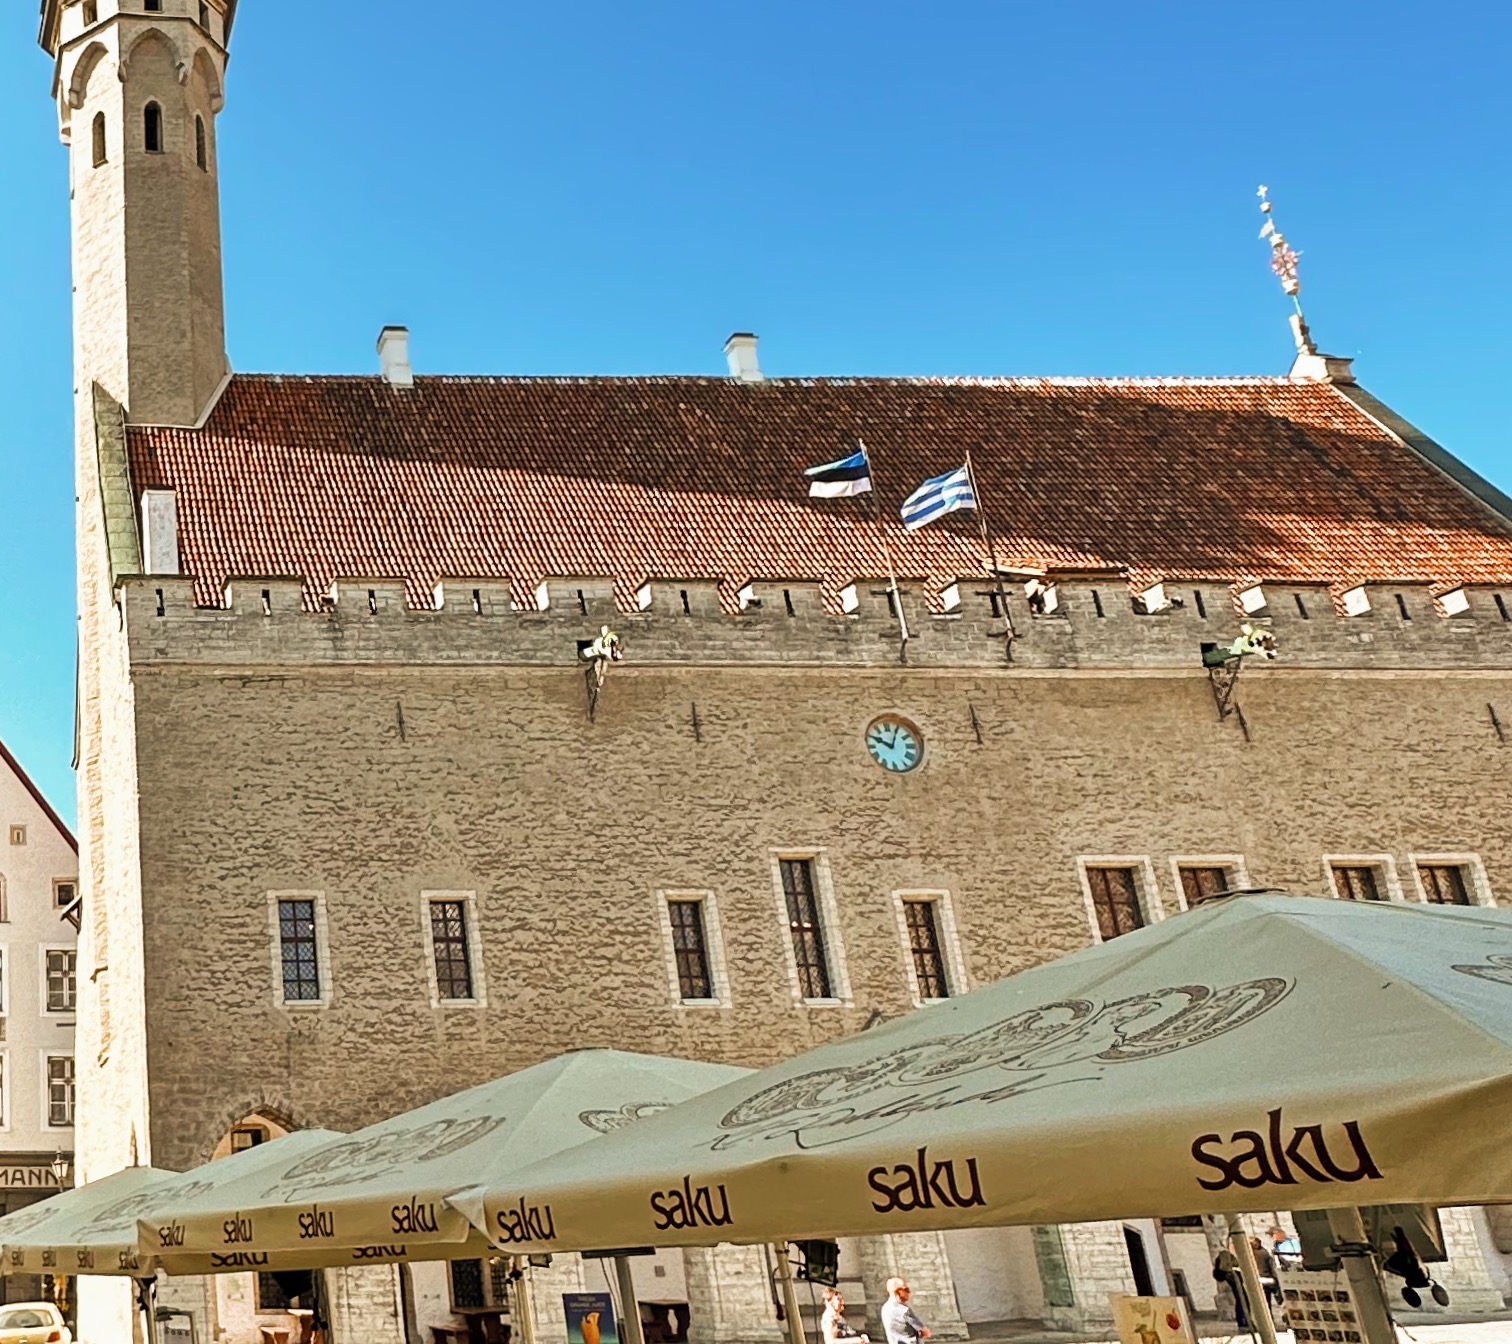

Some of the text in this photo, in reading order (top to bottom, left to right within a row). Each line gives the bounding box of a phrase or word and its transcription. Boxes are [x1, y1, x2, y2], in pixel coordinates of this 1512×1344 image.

[1192, 1107, 1384, 1191] saku
[868, 1146, 987, 1214] saku
[299, 1204, 334, 1238] saku
[392, 1195, 439, 1233] saku
[497, 1197, 557, 1243] saku
[650, 1175, 734, 1230] saku
[159, 1220, 185, 1247] saku
[223, 1211, 253, 1245] saku
